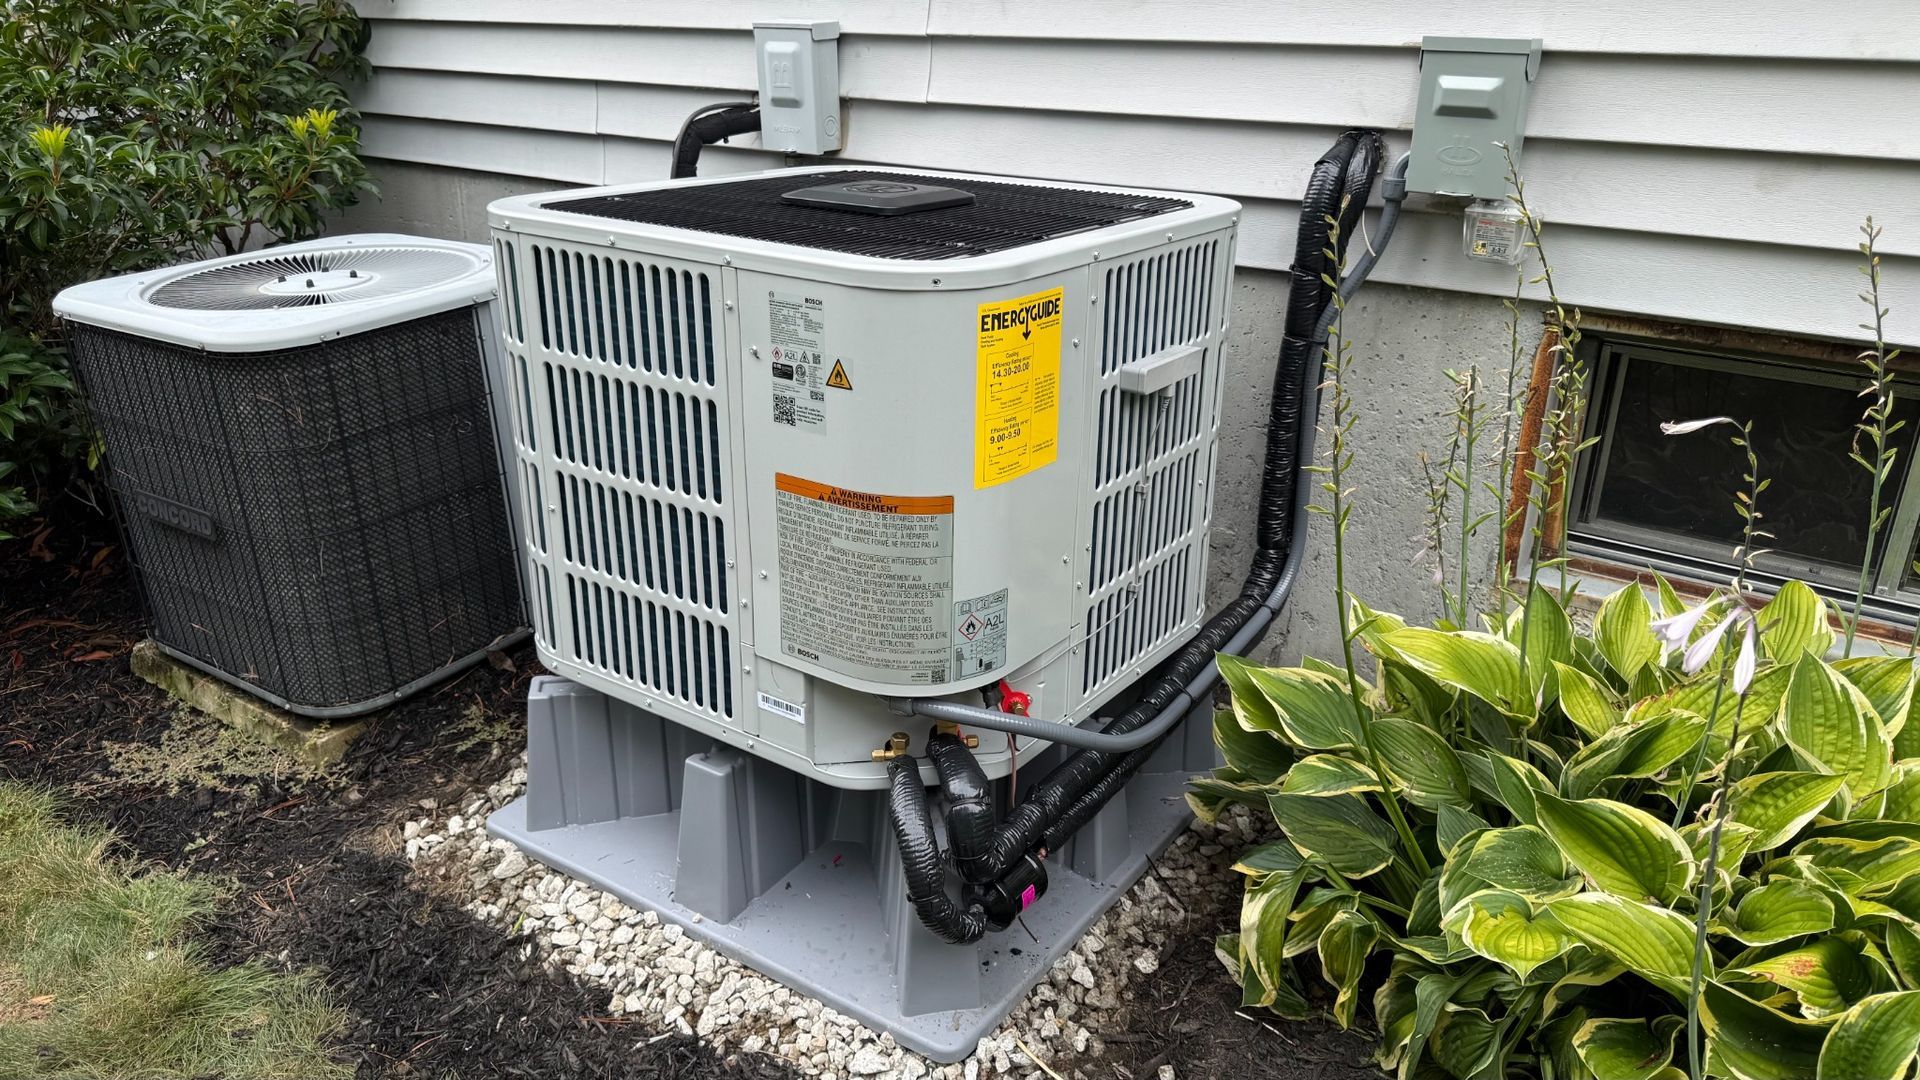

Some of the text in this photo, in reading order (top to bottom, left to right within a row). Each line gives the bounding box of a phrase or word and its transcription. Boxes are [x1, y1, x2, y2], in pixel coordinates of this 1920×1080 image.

[805, 298, 822, 306] BOSCH
[990, 428, 1020, 444] 9.00-9.50
[840, 490, 881, 503] WARNING
[828, 495, 898, 513] AVERTISSEMENT
[137, 495, 212, 536] CONCORD
[845, 525, 878, 537] INFLAMMABLE
[856, 518, 880, 529] PUNCTURE
[882, 522, 917, 531] REFRIGERANT
[851, 535, 870, 544] SERVICE
[841, 558, 876, 570] REFRIGERANT
[897, 582, 931, 590] INFLAMMABLE
[881, 590, 902, 598] IGNITION
[985, 614, 1004, 629] A2L
[798, 648, 819, 661] BOSCH
